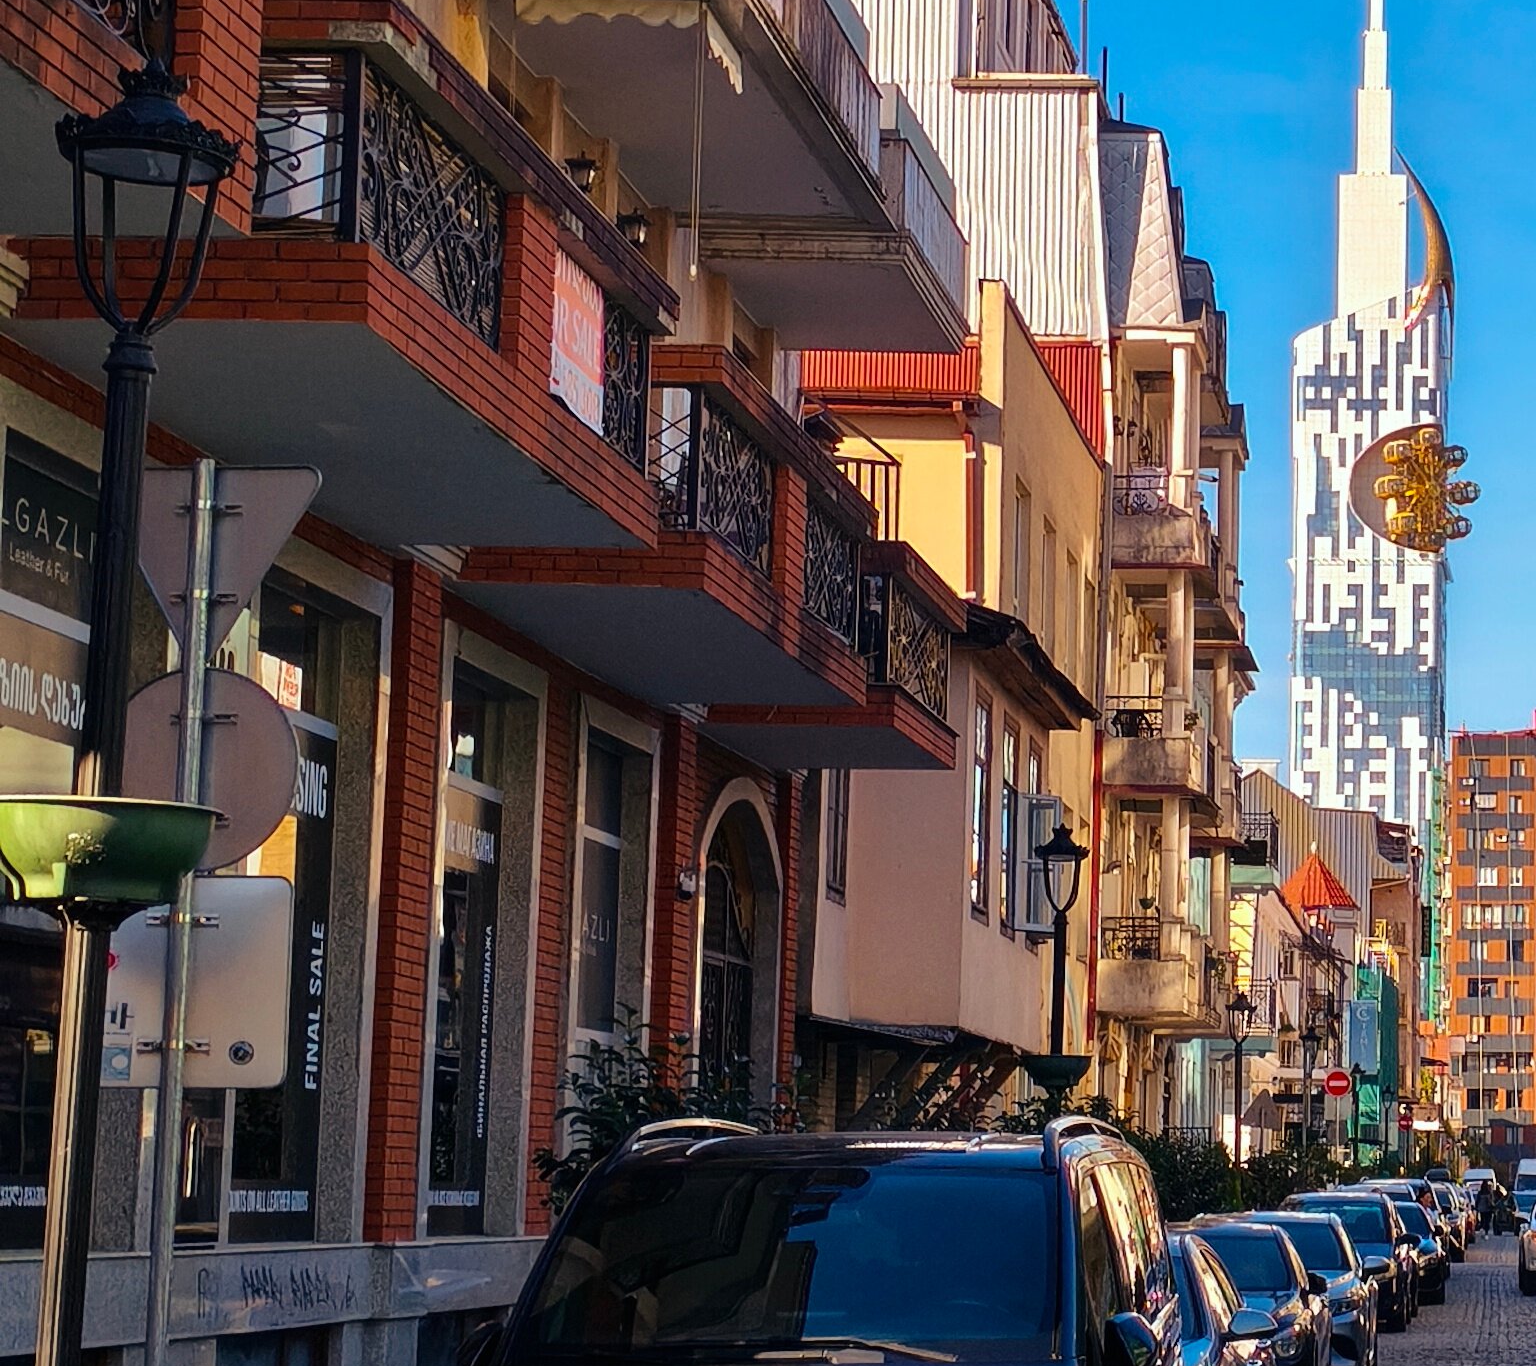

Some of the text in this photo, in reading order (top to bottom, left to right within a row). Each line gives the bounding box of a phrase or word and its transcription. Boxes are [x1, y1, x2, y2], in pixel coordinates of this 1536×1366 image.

[572, 309, 601, 374] SALE
[9, 541, 43, 574] Leather
[305, 920, 325, 1090] FINAL SALE
[481, 925, 493, 1035] РАСПРОДАЖА
